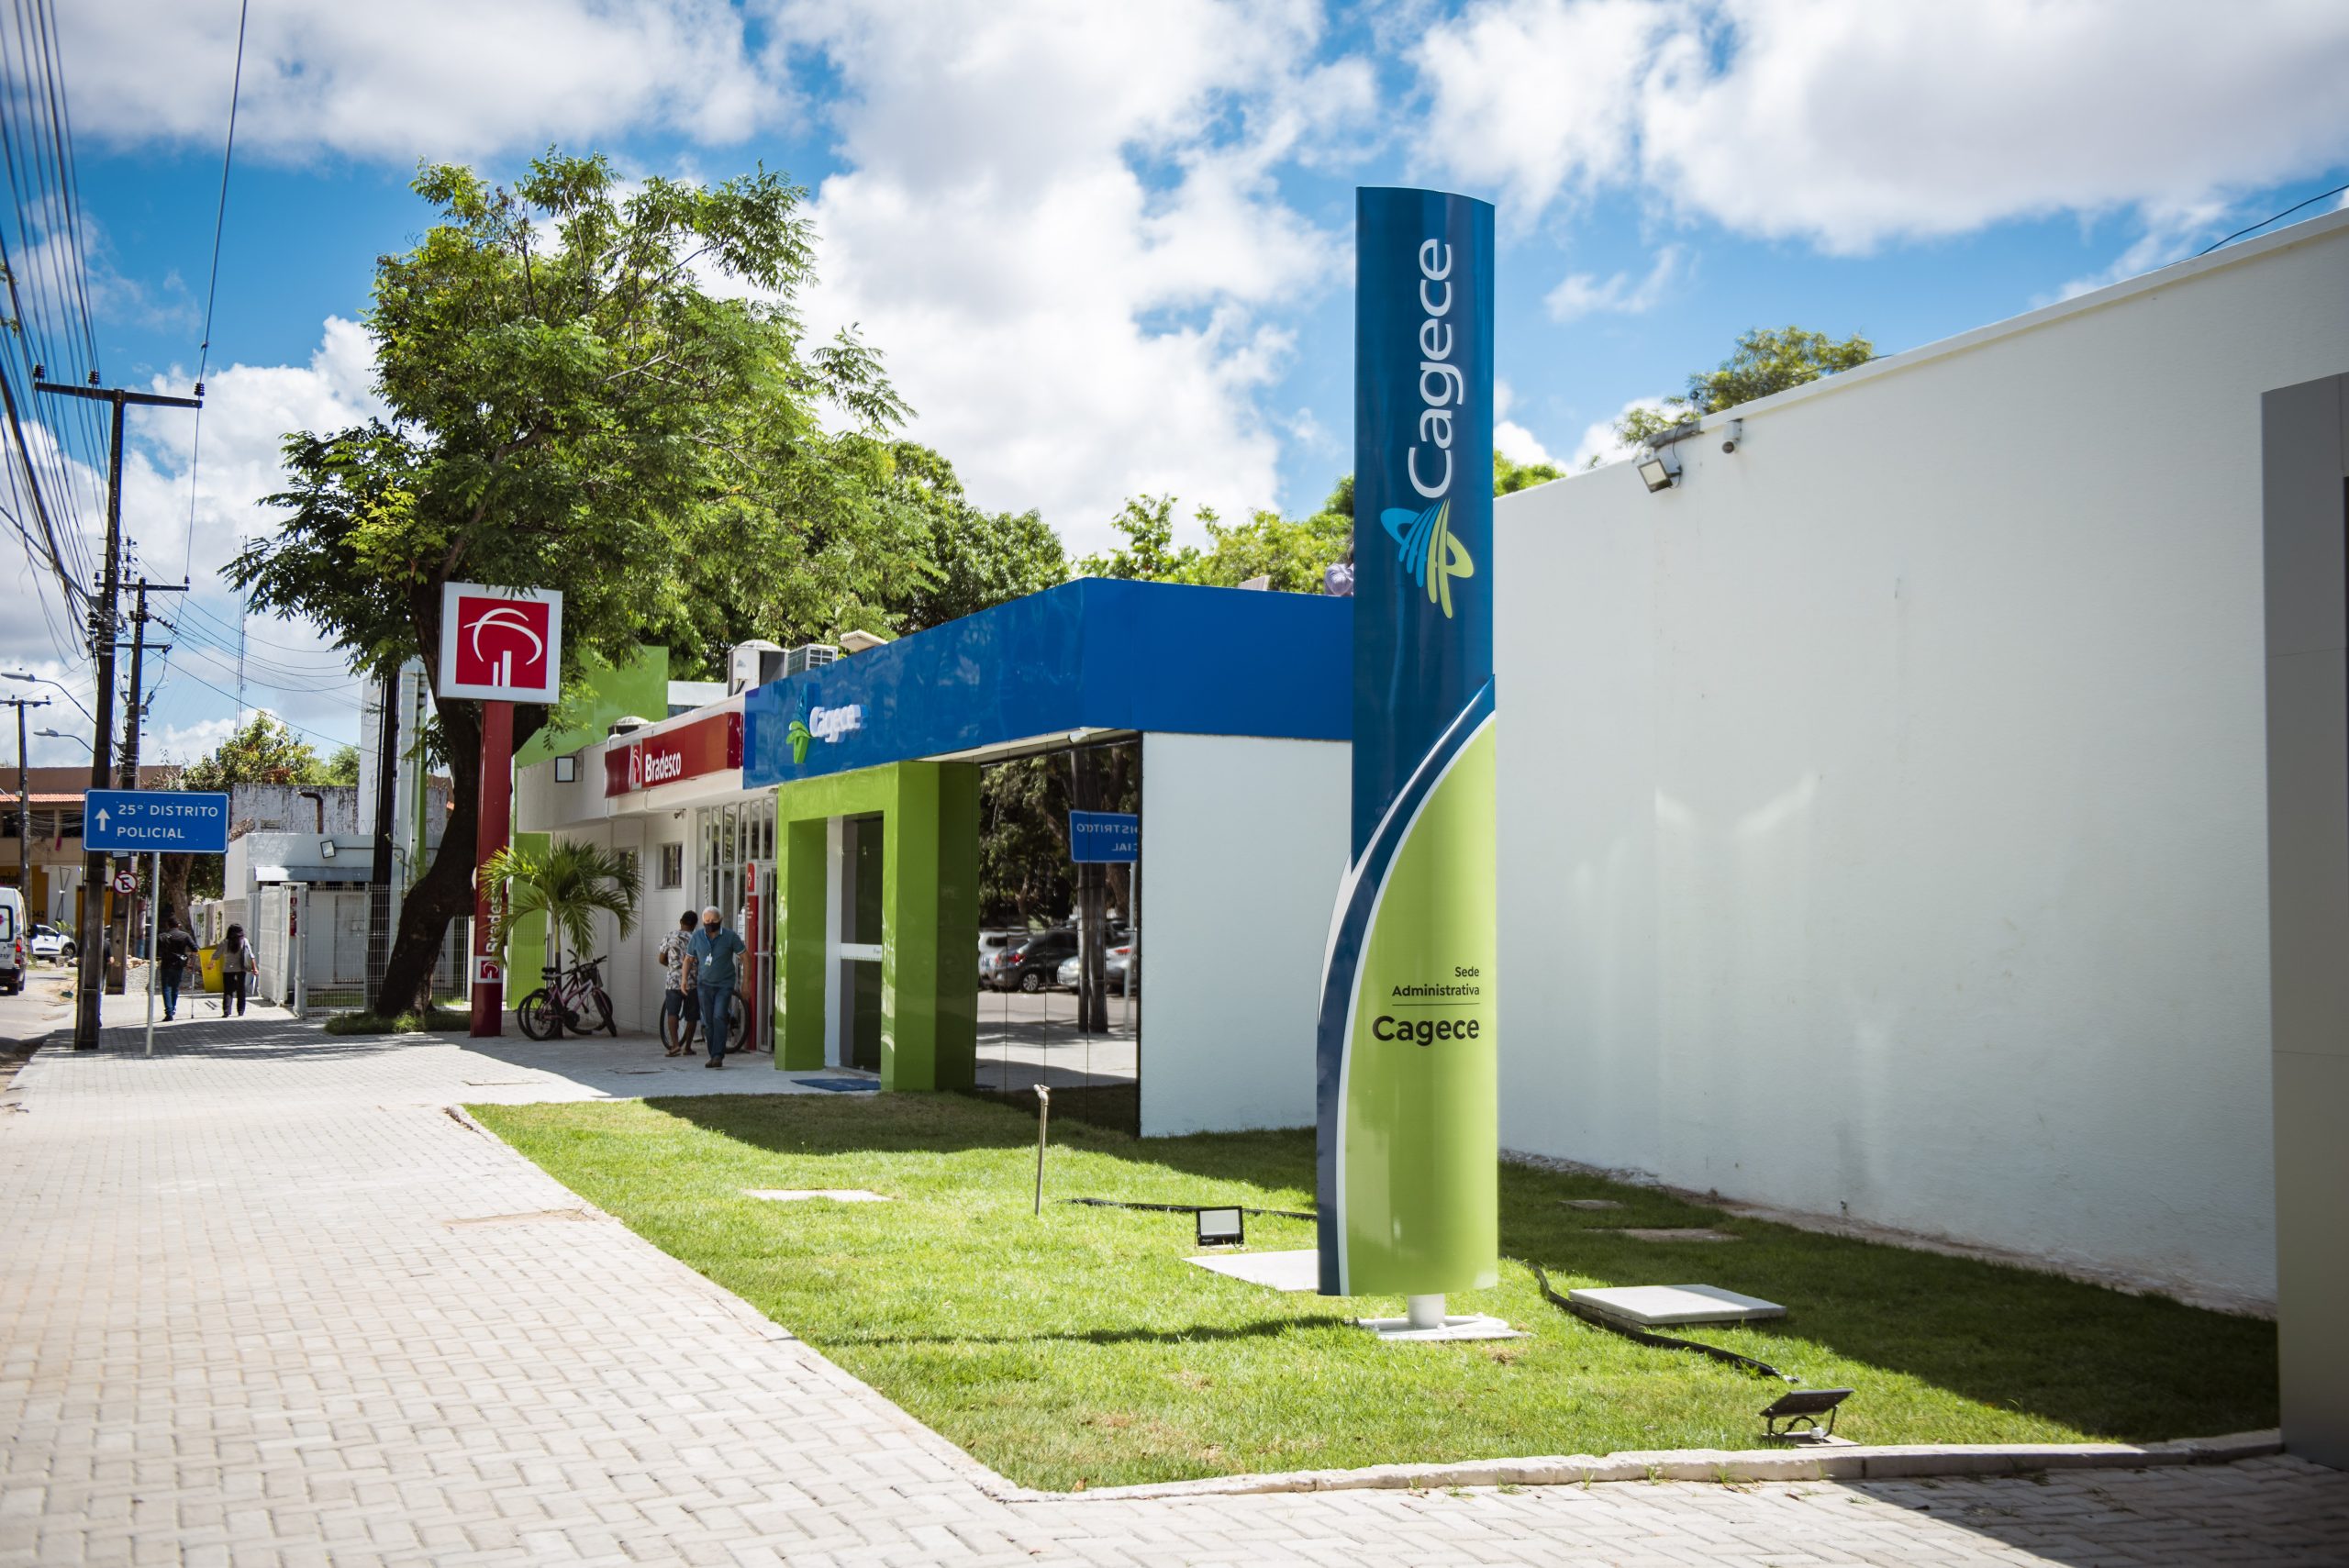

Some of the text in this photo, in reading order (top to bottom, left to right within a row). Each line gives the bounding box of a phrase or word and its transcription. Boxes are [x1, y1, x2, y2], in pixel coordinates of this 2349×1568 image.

[1408, 239, 1464, 498] Cagece
[645, 750, 682, 783] Bradesco
[150, 805, 218, 817] DISTRITO
[117, 827, 185, 839] POLICIAL
[1454, 966, 1480, 978] Sede
[1392, 984, 1480, 997] Administrativa
[1372, 1015, 1480, 1047] Cagece
